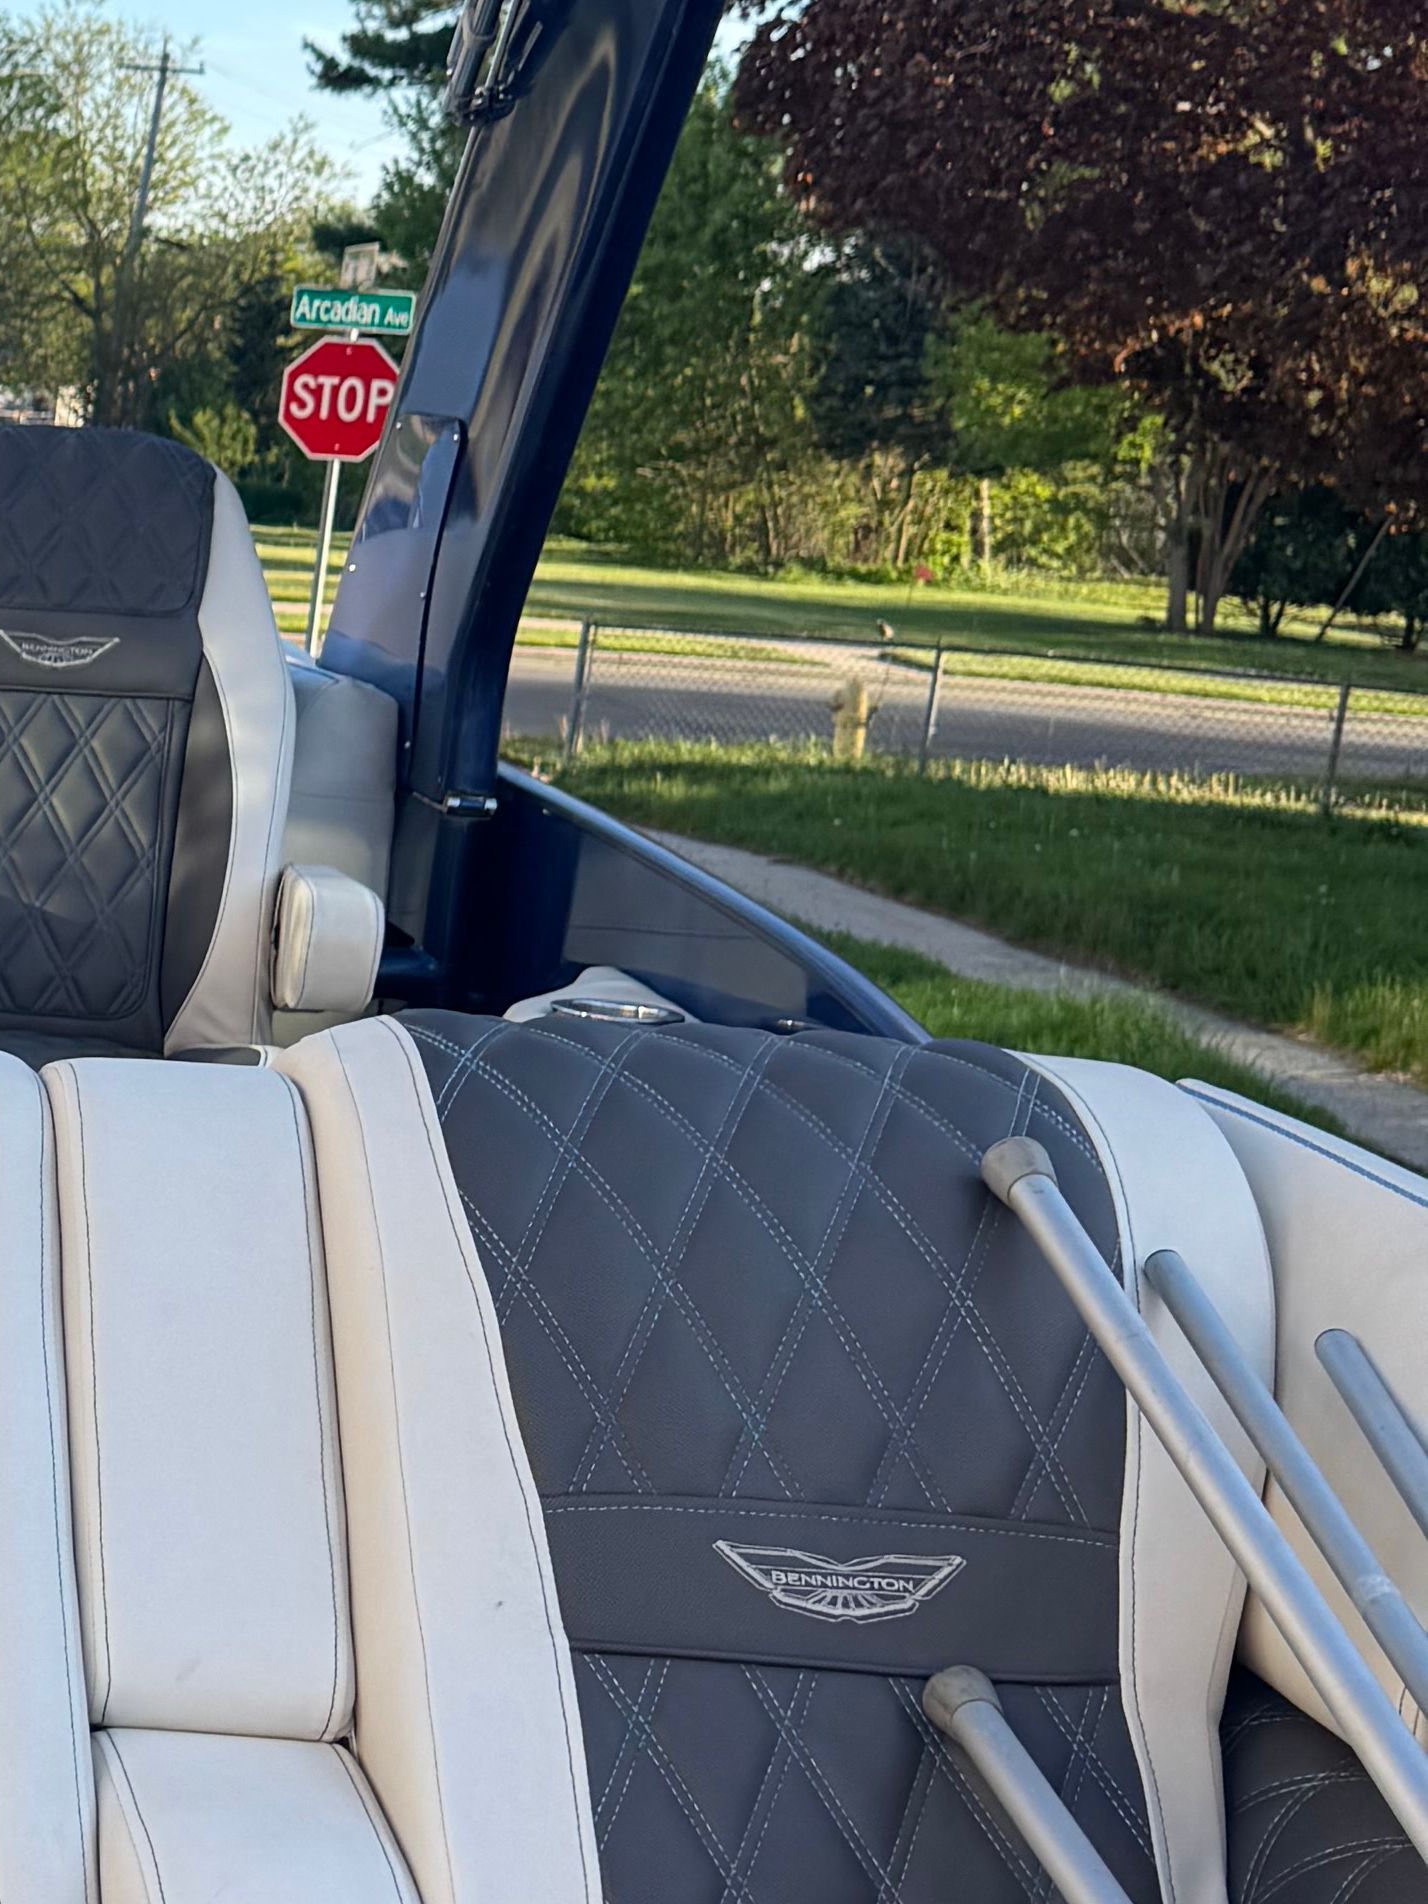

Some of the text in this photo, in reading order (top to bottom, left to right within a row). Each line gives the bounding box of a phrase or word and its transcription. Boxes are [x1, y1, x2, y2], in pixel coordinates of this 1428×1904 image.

[295, 294, 409, 327] Arcadian Ave
[289, 374, 394, 423] STOP
[771, 1570, 914, 1592] BENNINGTON
